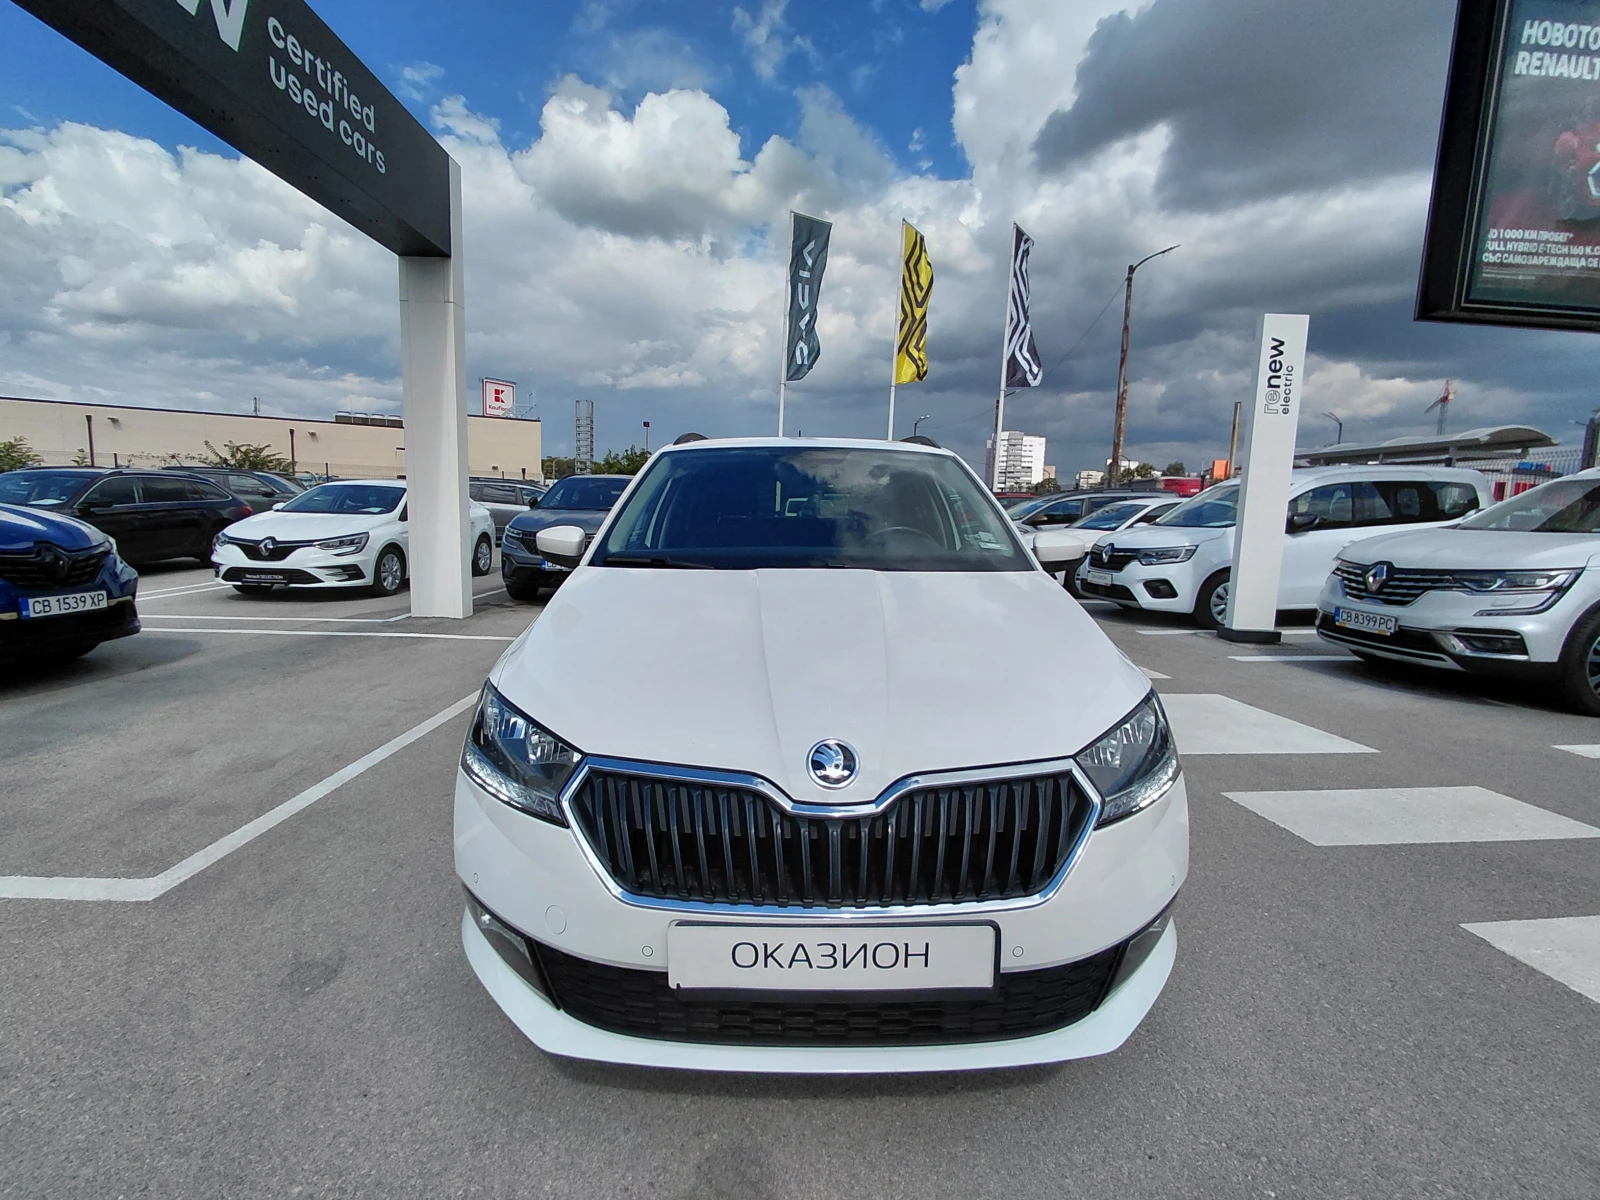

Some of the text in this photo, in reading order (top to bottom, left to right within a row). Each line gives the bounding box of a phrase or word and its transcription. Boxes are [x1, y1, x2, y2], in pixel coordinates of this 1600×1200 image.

[1521, 20, 1600, 51] НОВОТО
[267, 16, 375, 134] certified
[1514, 51, 1600, 80] RENAULT
[269, 55, 386, 174] used cars
[1506, 241, 1538, 253] HYBRID
[1264, 337, 1285, 415] renew
[1280, 365, 1294, 415] electric
[32, 599, 52, 615] CB
[55, 594, 87, 612] 1539
[1353, 613, 1378, 627] 8399
[731, 941, 930, 970] ОКАЗИОН
